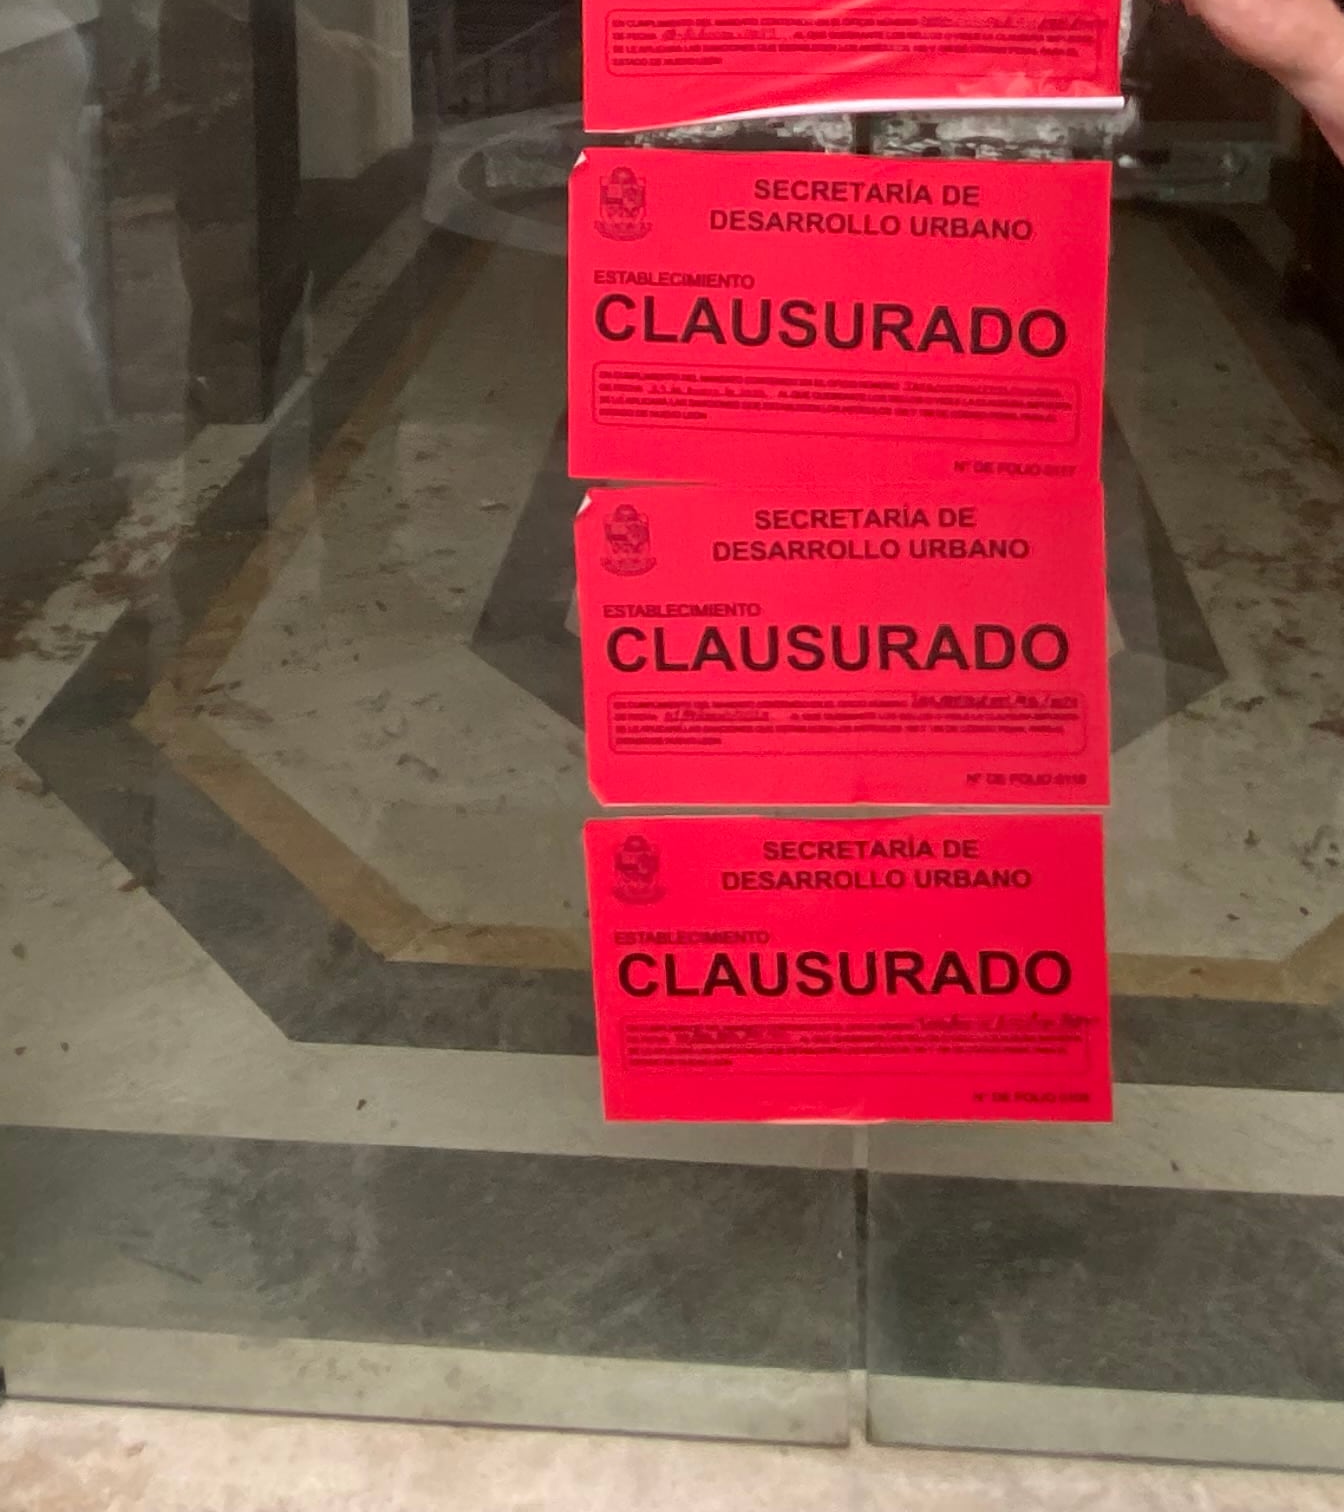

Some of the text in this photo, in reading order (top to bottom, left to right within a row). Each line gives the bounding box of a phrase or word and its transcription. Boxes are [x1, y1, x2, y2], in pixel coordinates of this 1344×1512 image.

[754, 176, 981, 207] SECRETARÍA DE
[710, 209, 1034, 242] DESARROLLO URBANO
[593, 270, 756, 290] ESTABLECIMIENTO
[595, 292, 1068, 359] CLAUSURADO
[754, 501, 976, 530] SECRETARÍA DE
[712, 536, 1031, 563] DESARROLLO URBANO
[603, 602, 762, 619] ESTABLECIMIENTO
[606, 621, 1070, 674] CLAUSURADO
[762, 834, 980, 861] SECRETARÍA DE
[722, 867, 1033, 891] DESARROLLO URBANO
[617, 948, 1073, 998] CLAUSURADO
